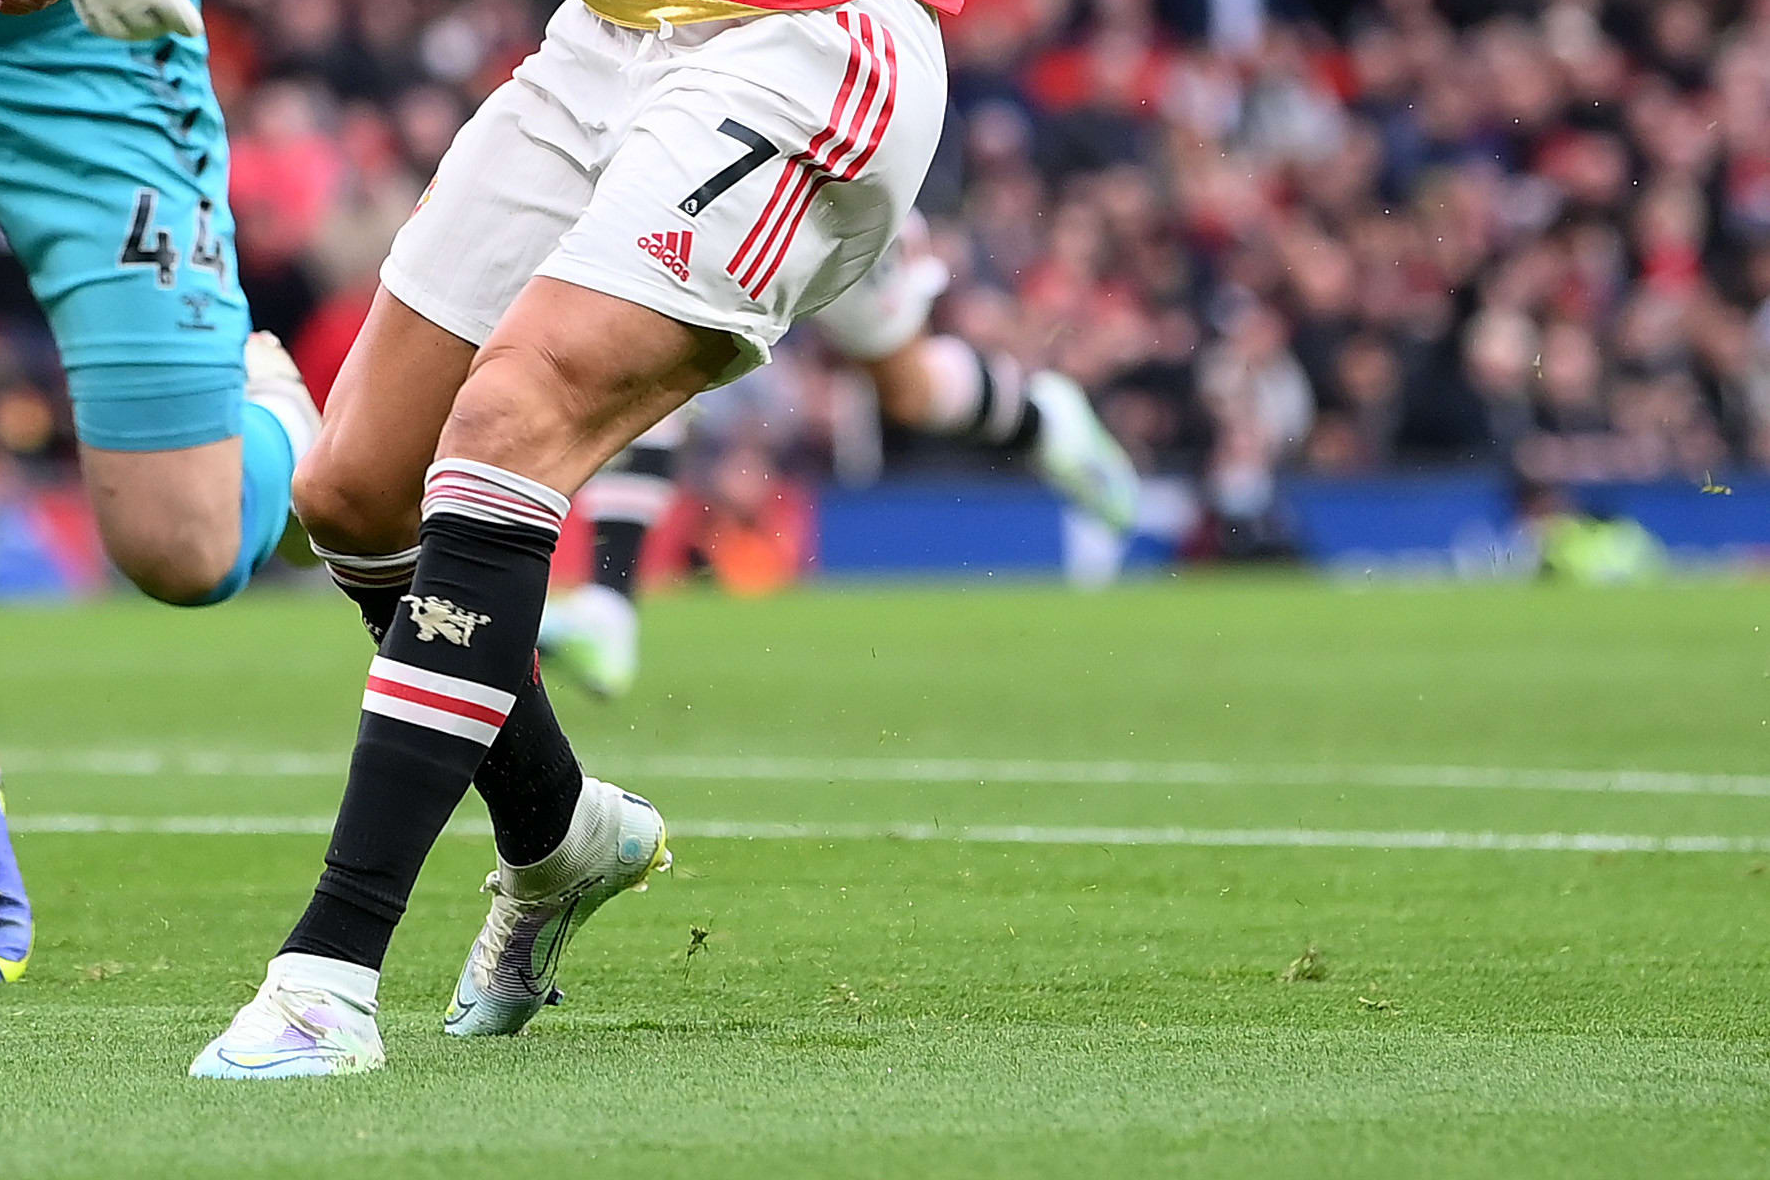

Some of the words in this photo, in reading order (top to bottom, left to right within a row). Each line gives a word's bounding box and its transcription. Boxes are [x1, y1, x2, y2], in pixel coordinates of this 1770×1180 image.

[677, 117, 780, 217] 7
[118, 187, 226, 294] 44
[637, 236, 690, 282] adidas
